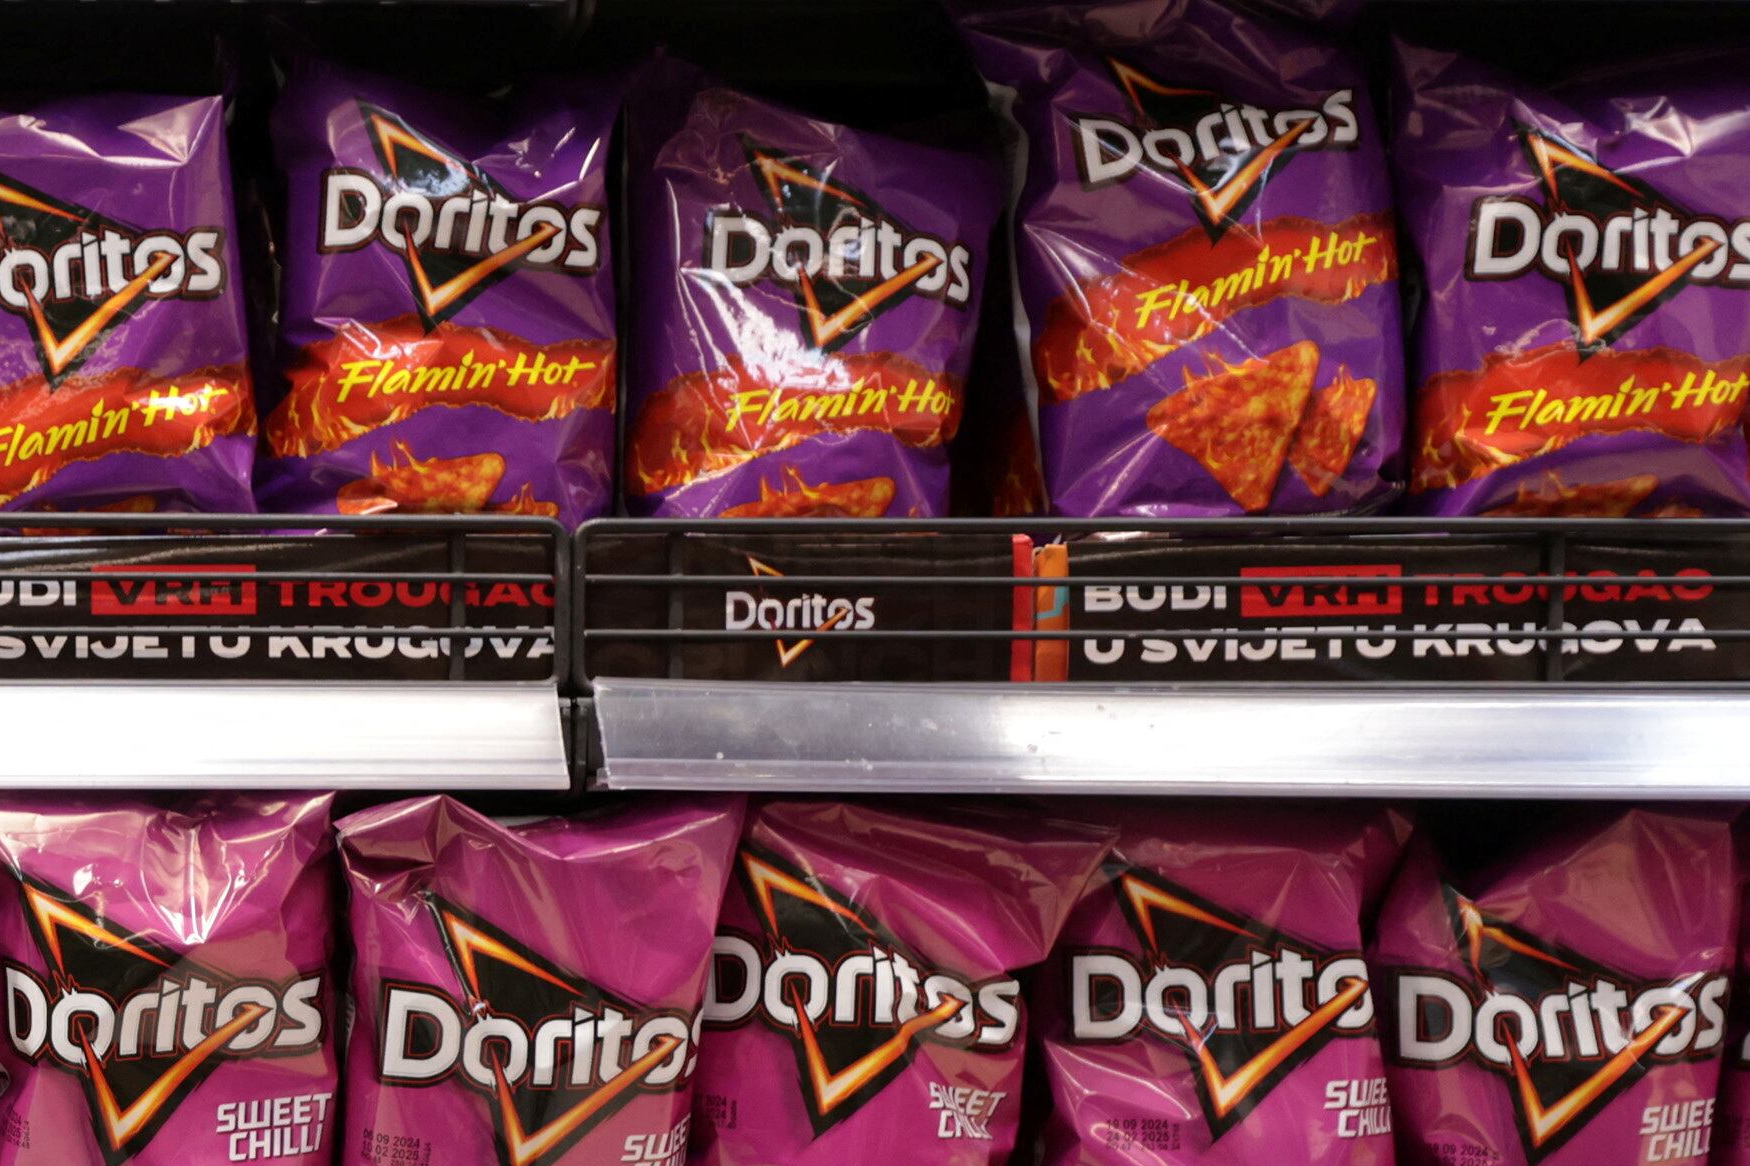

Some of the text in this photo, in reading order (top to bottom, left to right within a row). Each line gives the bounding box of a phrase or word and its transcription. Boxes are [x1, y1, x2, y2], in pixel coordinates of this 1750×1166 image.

[1080, 90, 1358, 182] Doritos
[323, 172, 600, 268] Doritos
[711, 212, 970, 300] Doritos
[726, 591, 875, 631] Doritos
[1084, 583, 1227, 612] BUDI
[1084, 617, 1716, 664] U SVIJETU KRUGOVA
[706, 936, 1019, 1043] Doritos
[1074, 953, 1374, 1040] Dorito
[4, 965, 321, 1065] Doritos
[1400, 974, 1729, 1063] Doritos
[216, 1092, 333, 1134] SWEET
[929, 1082, 1006, 1116] SWEET
[1325, 1077, 1388, 1110] SWEE
[621, 1117, 690, 1162] SWEE
[1641, 1101, 1714, 1136] SWEE
[229, 1122, 323, 1161] CHILLI
[1648, 1132, 1710, 1163] CHILL
